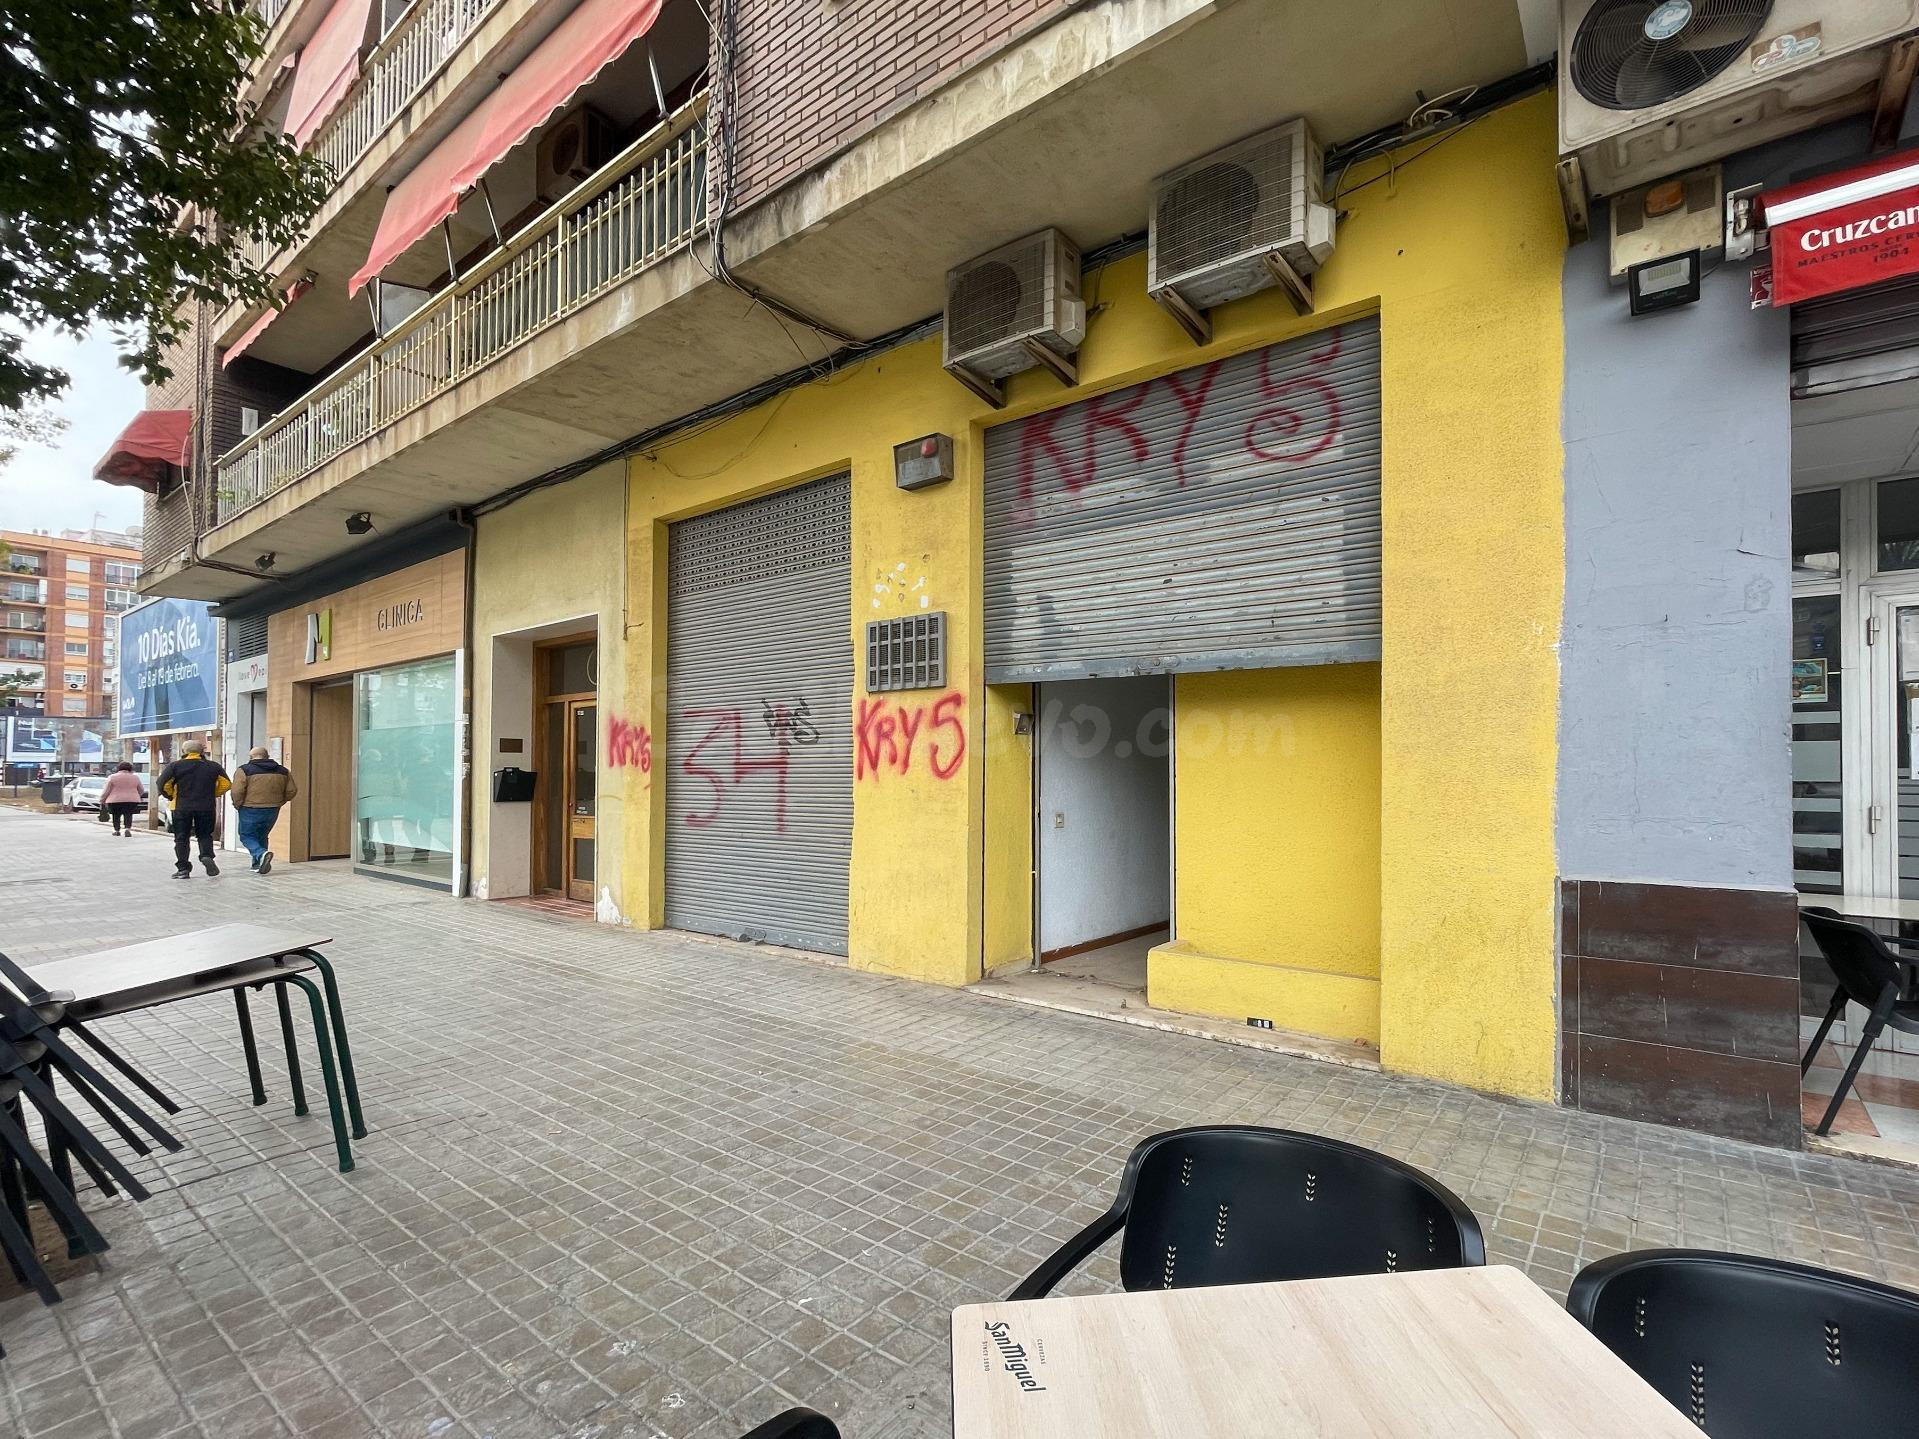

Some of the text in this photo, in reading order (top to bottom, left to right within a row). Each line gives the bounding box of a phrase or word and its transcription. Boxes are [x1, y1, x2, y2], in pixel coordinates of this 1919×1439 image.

[1797, 242, 1879, 268] MAESTROS
[138, 616, 201, 664] 10 Días Kia.
